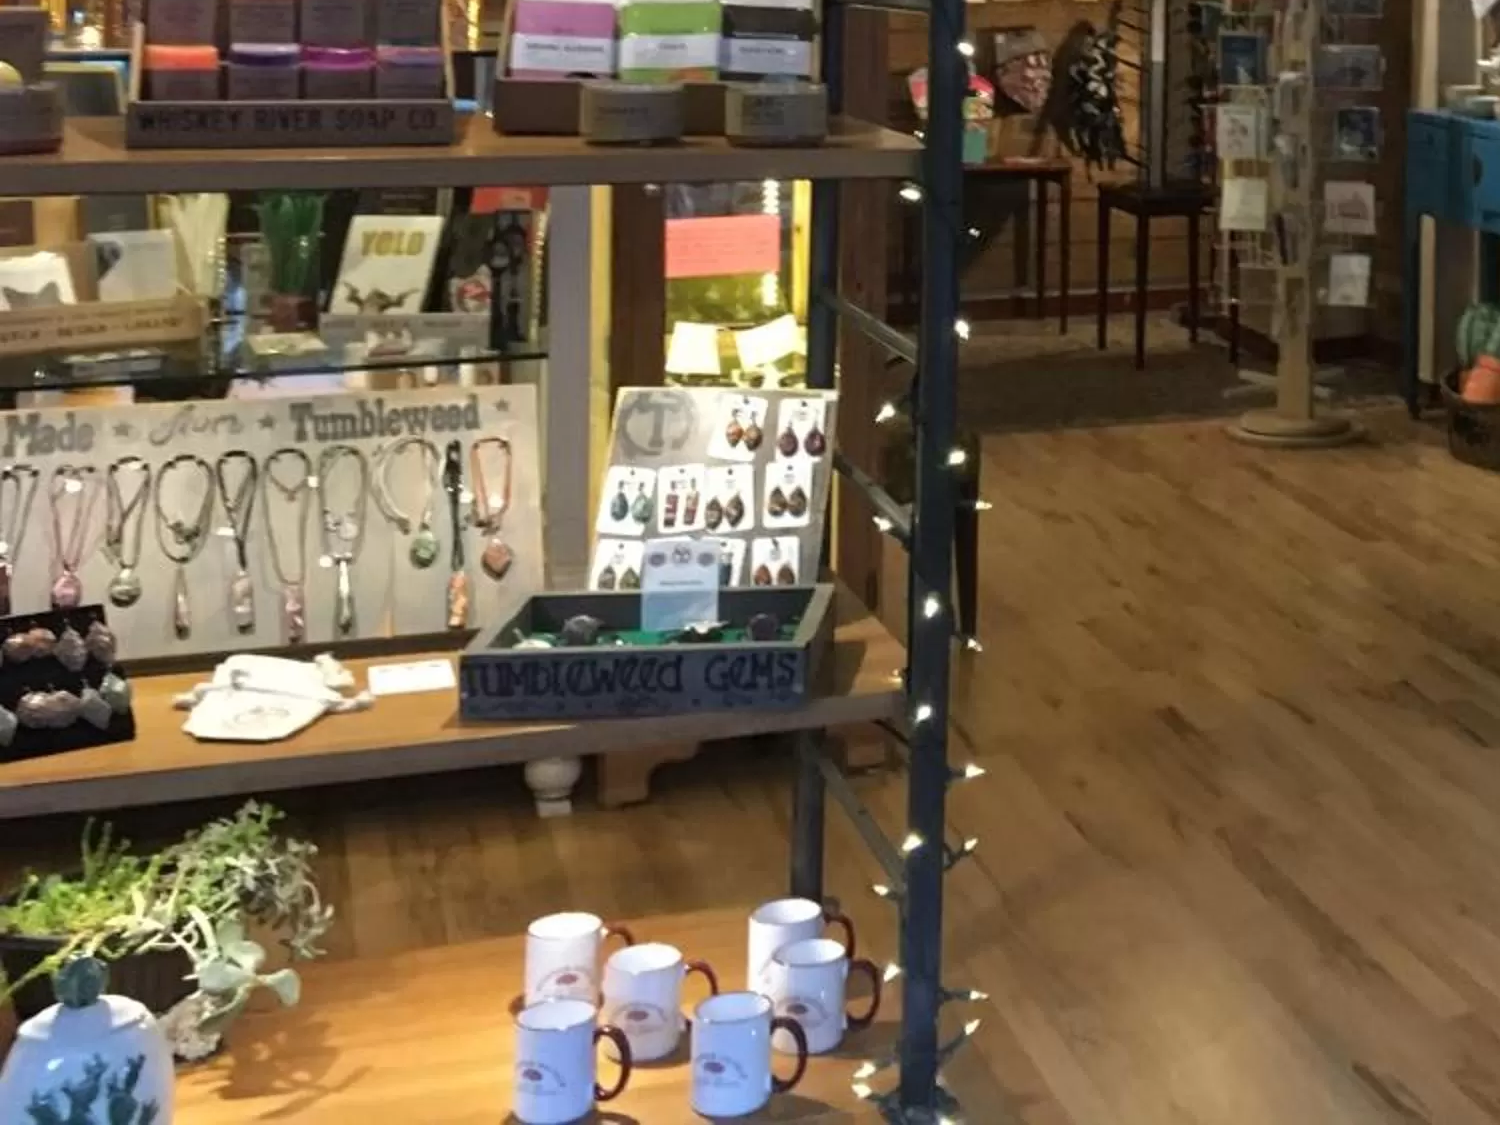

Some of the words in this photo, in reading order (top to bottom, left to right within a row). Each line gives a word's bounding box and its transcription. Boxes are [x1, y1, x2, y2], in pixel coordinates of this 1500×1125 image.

[136, 108, 243, 132] WHISKEY
[253, 108, 323, 132] RIVER
[335, 107, 396, 131] SOAP
[360, 228, 426, 257] YOLO
[2, 411, 95, 458] Made
[289, 393, 481, 443] Tumbleweed
